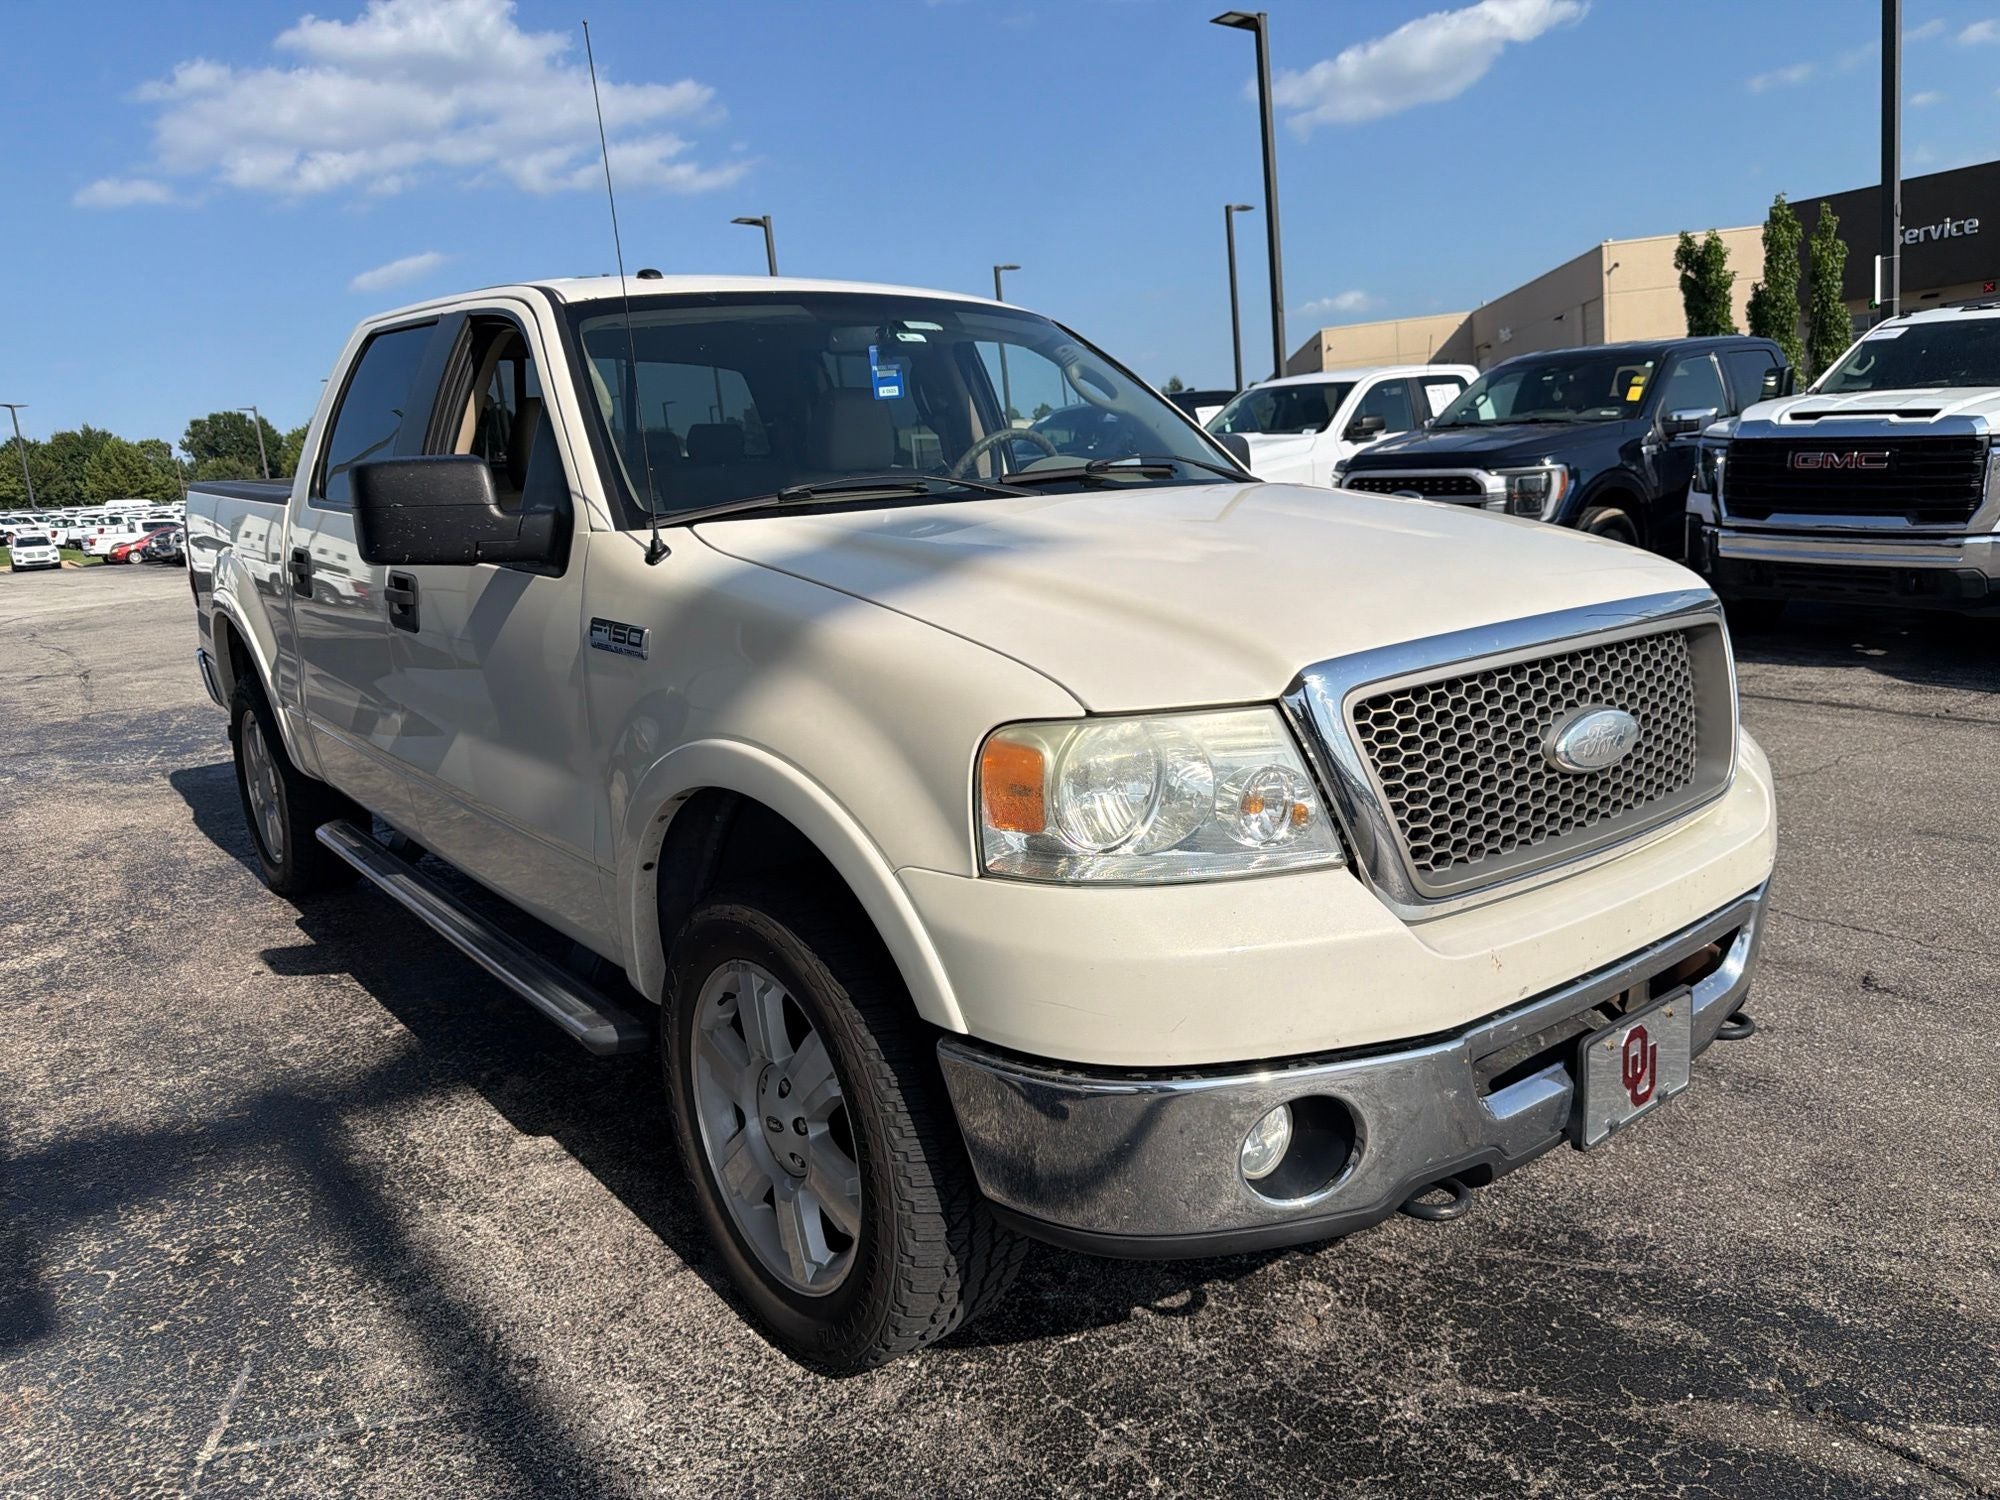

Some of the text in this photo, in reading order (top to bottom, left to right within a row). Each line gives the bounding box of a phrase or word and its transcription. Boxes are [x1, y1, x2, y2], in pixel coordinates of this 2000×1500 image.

[1794, 451, 1889, 469] GMC
[1575, 722, 1626, 757] Ford
[1621, 1023, 1657, 1107] OU
